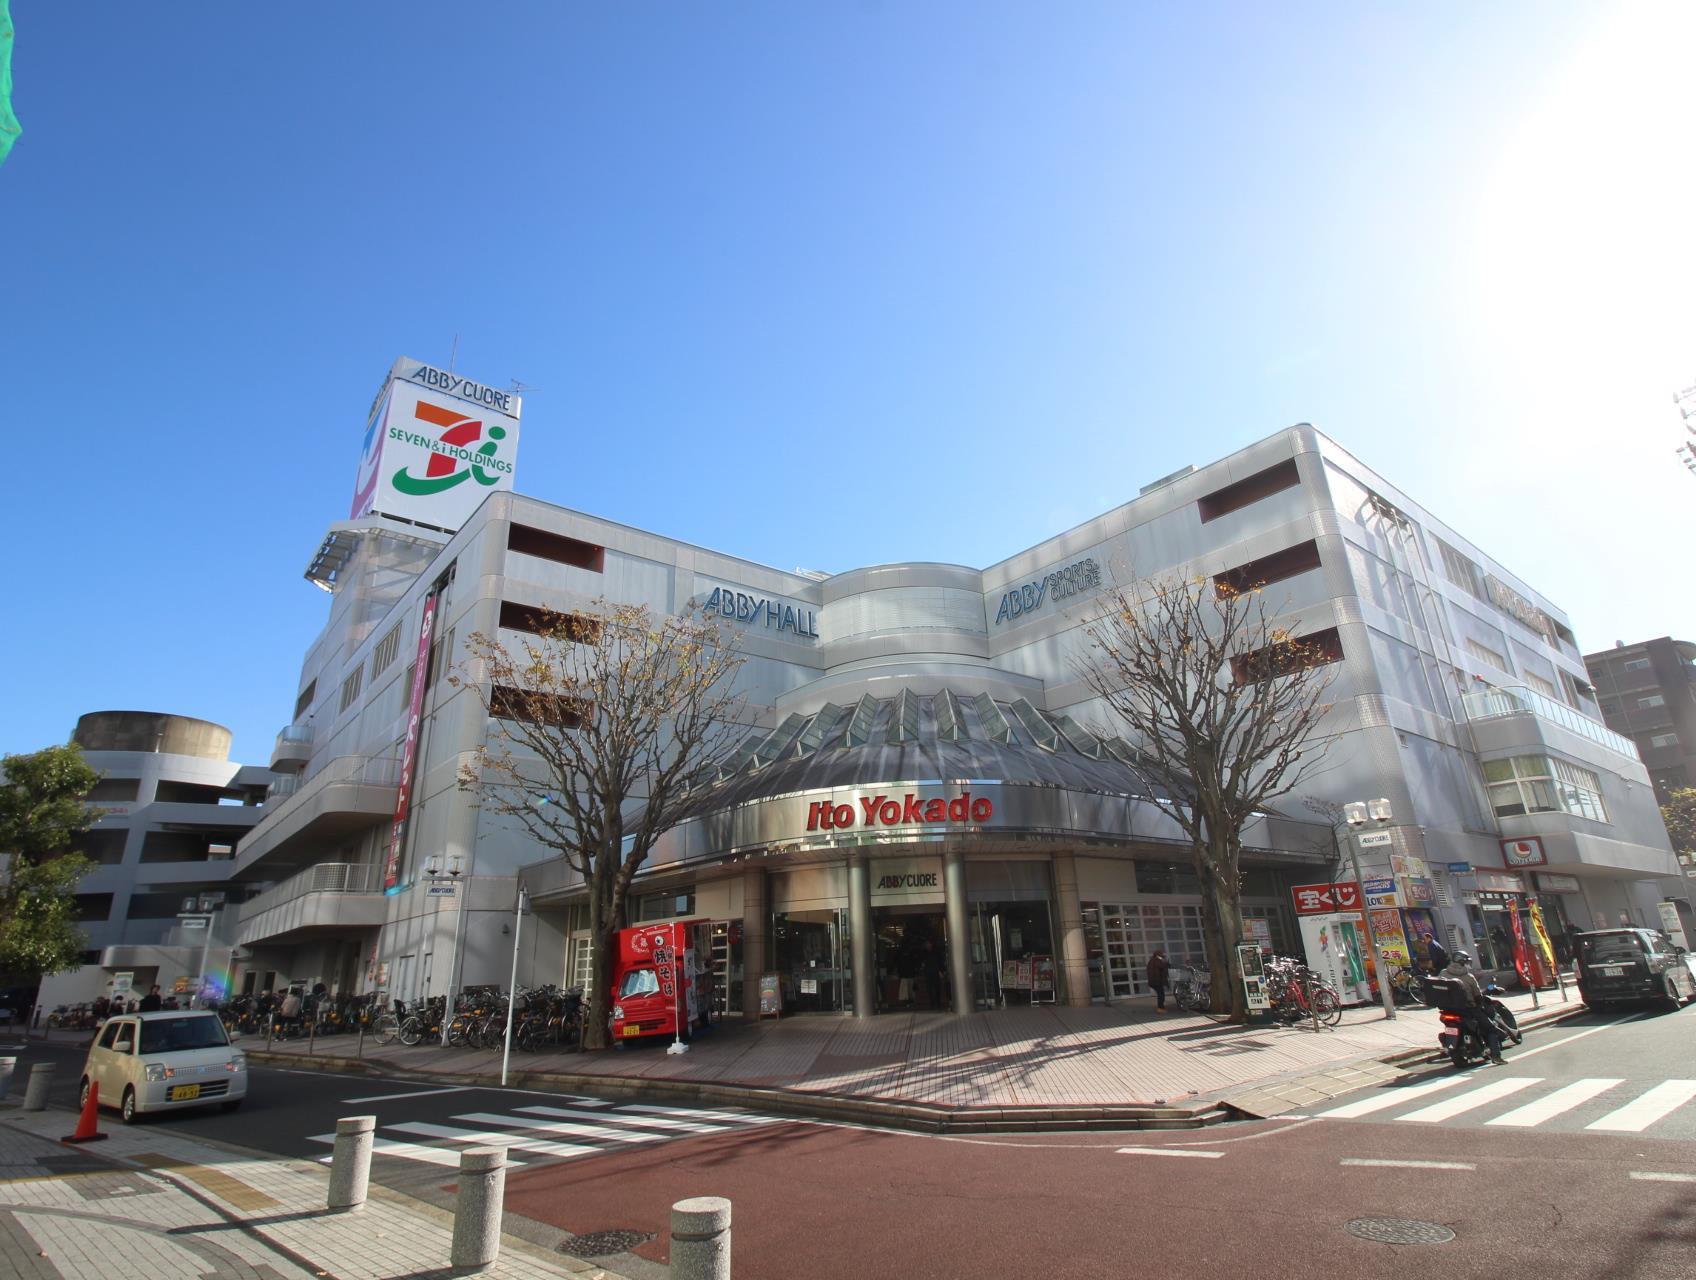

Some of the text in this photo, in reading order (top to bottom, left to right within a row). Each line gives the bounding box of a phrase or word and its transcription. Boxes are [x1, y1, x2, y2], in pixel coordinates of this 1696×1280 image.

[449, 444, 513, 474] HOLDINGS
[995, 576, 1049, 626] ABBY
[1050, 570, 1102, 602] CULTURE
[806, 791, 993, 831] Ito Yokado
[1298, 887, 1356, 910] 宝くじ
